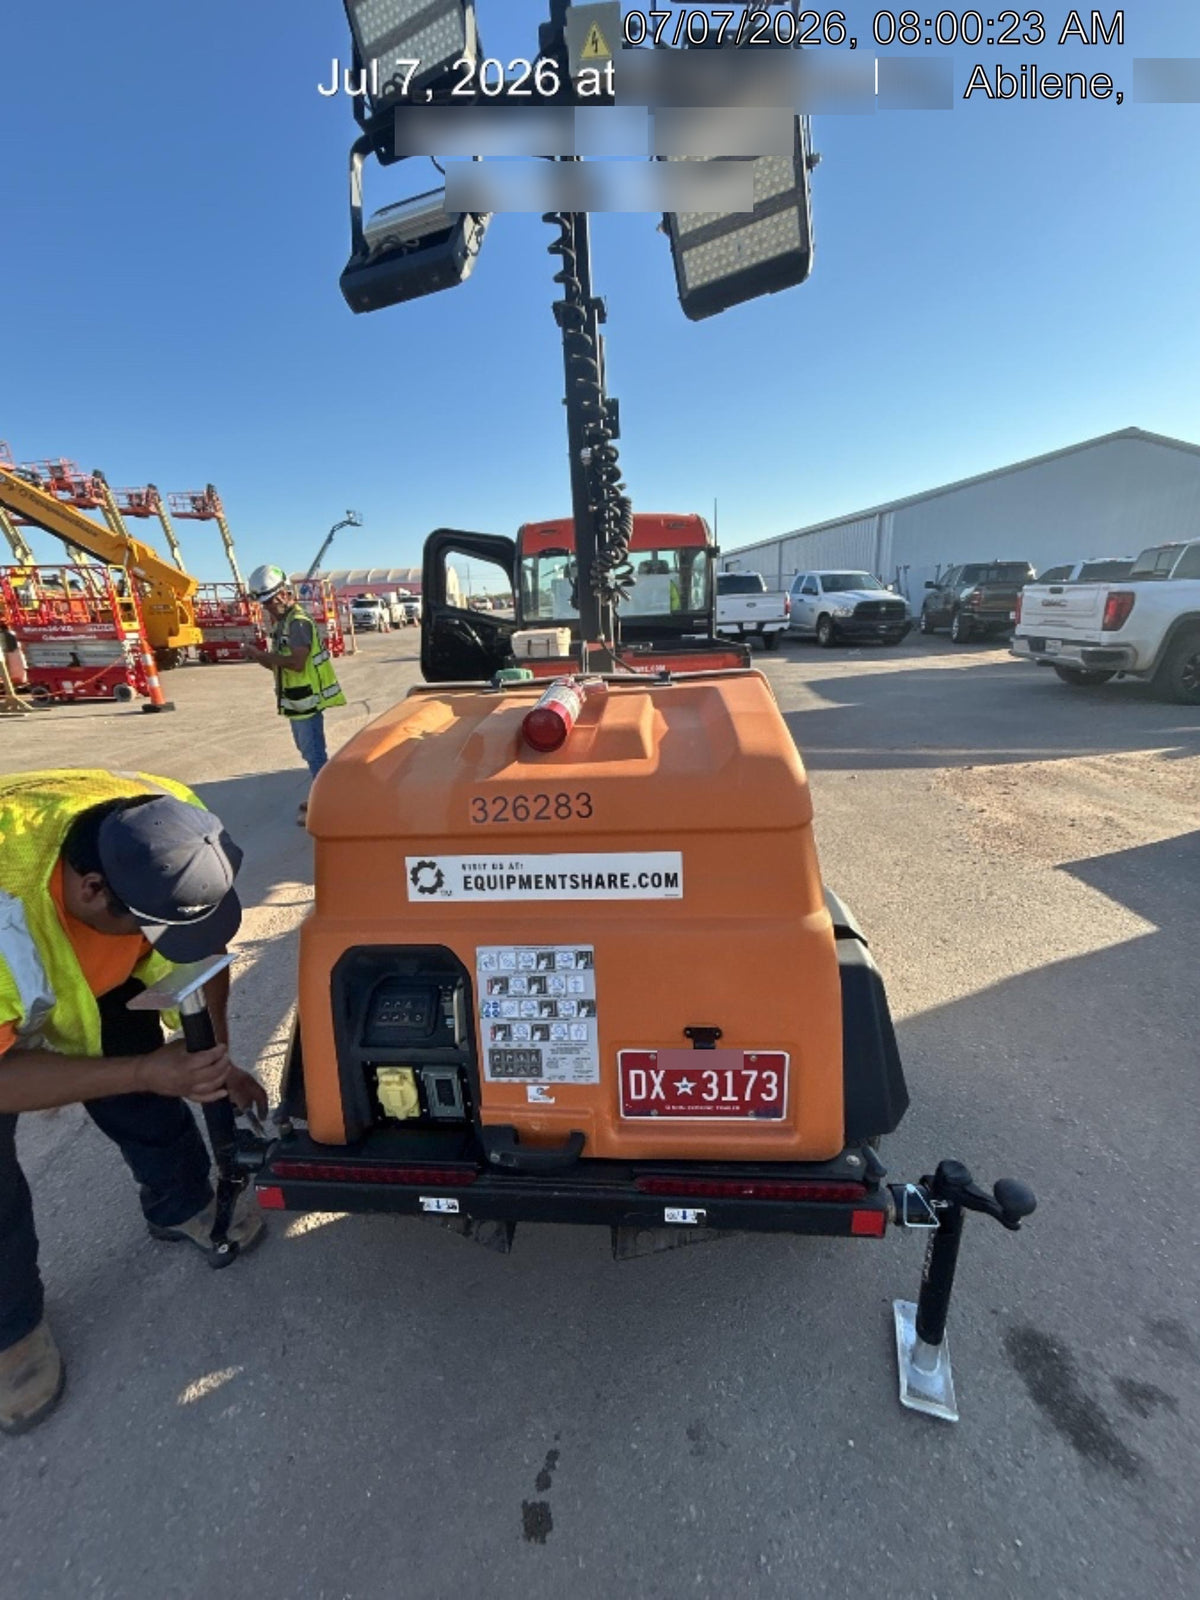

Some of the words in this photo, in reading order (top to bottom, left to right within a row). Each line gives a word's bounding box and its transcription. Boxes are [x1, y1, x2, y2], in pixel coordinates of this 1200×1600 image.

[471, 792, 593, 824] 326283
[463, 872, 679, 892] EQUIPMENTSHARE.COM
[629, 1069, 666, 1100] DX
[701, 1070, 779, 1102] 3173
